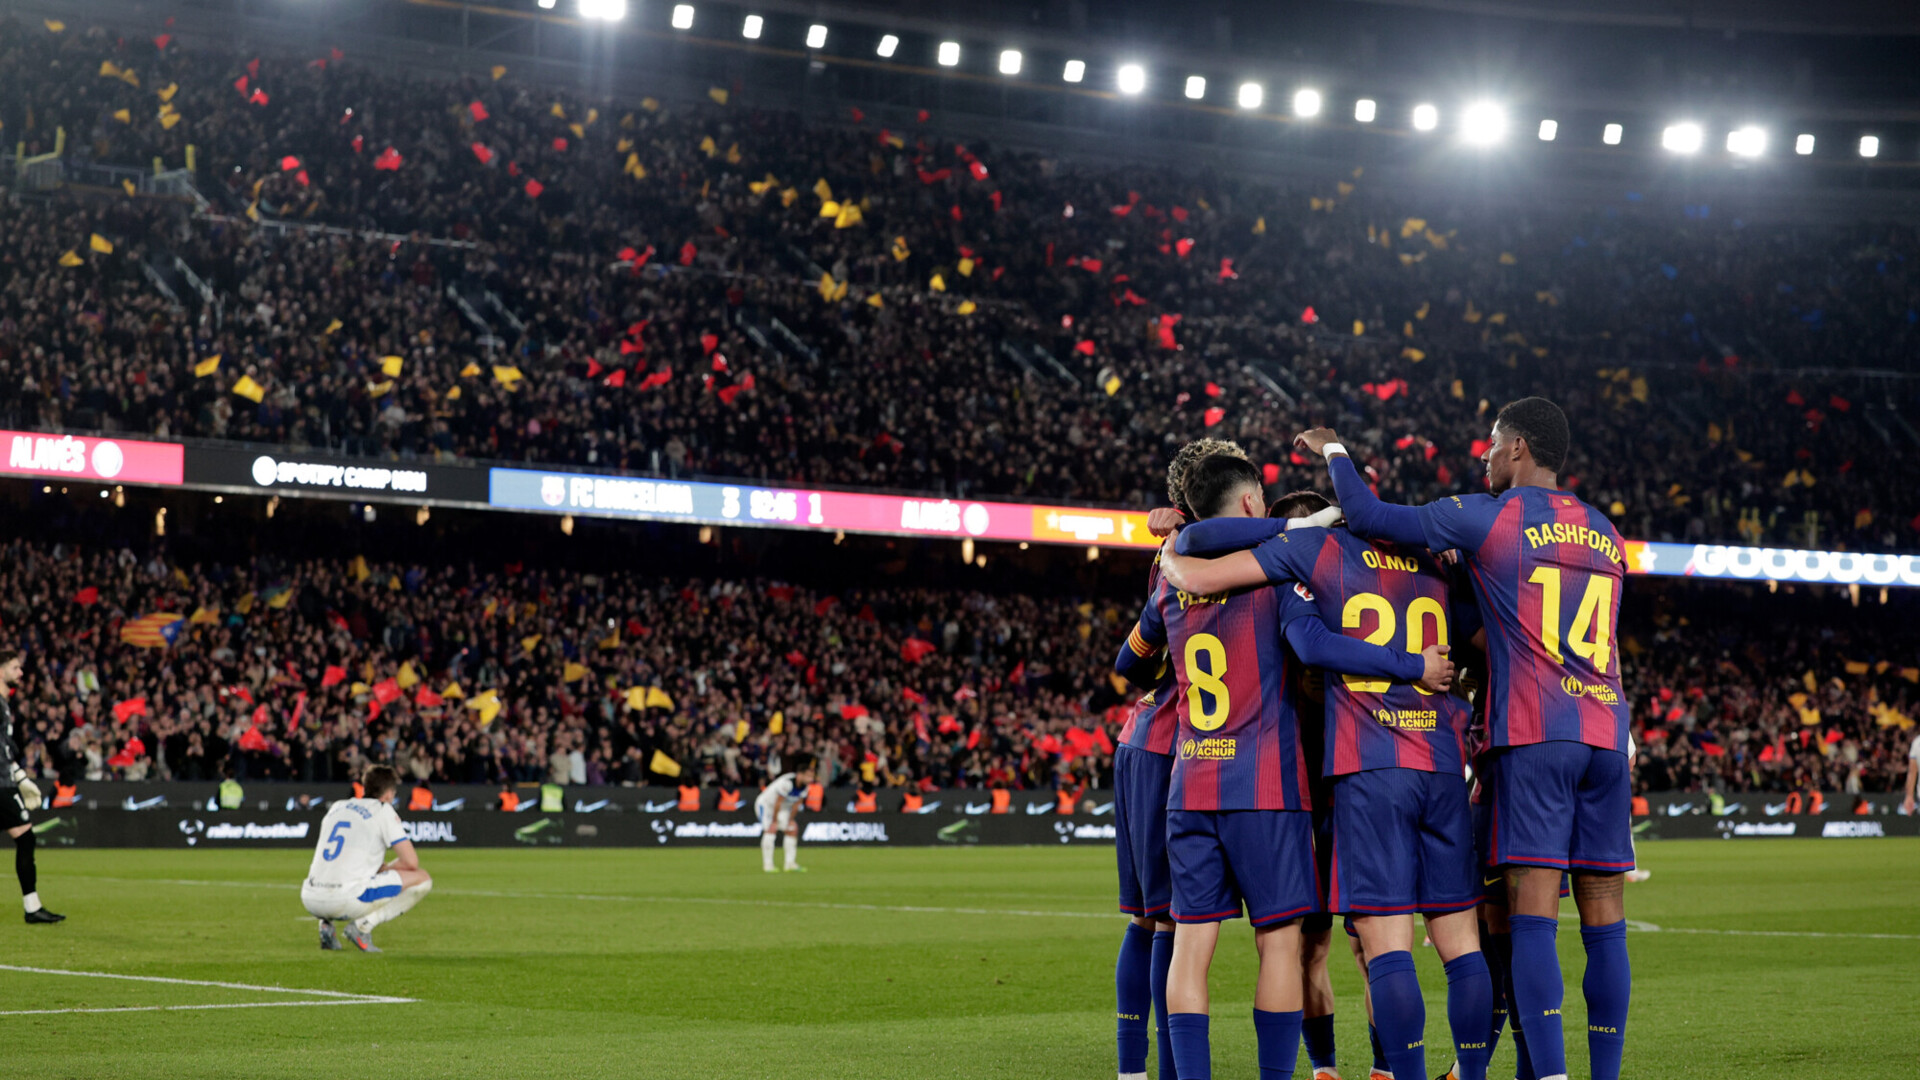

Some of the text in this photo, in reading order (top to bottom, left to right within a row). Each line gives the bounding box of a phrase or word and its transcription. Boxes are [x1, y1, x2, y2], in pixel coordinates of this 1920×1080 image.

[570, 477, 594, 508] FC
[722, 486, 741, 518] 3
[808, 493, 823, 524] 1
[1361, 550, 1419, 573] OLMO
[1523, 522, 1623, 565] RASHFORD
[1527, 566, 1613, 673] 14
[1341, 592, 1449, 696] 20
[1184, 632, 1230, 731] 8
[1397, 710, 1437, 719] UNHCR
[1399, 718, 1437, 728] ACNUR
[1197, 747, 1237, 756] ACNUR
[322, 821, 352, 861] 5
[801, 821, 890, 841] MERCURIAL
